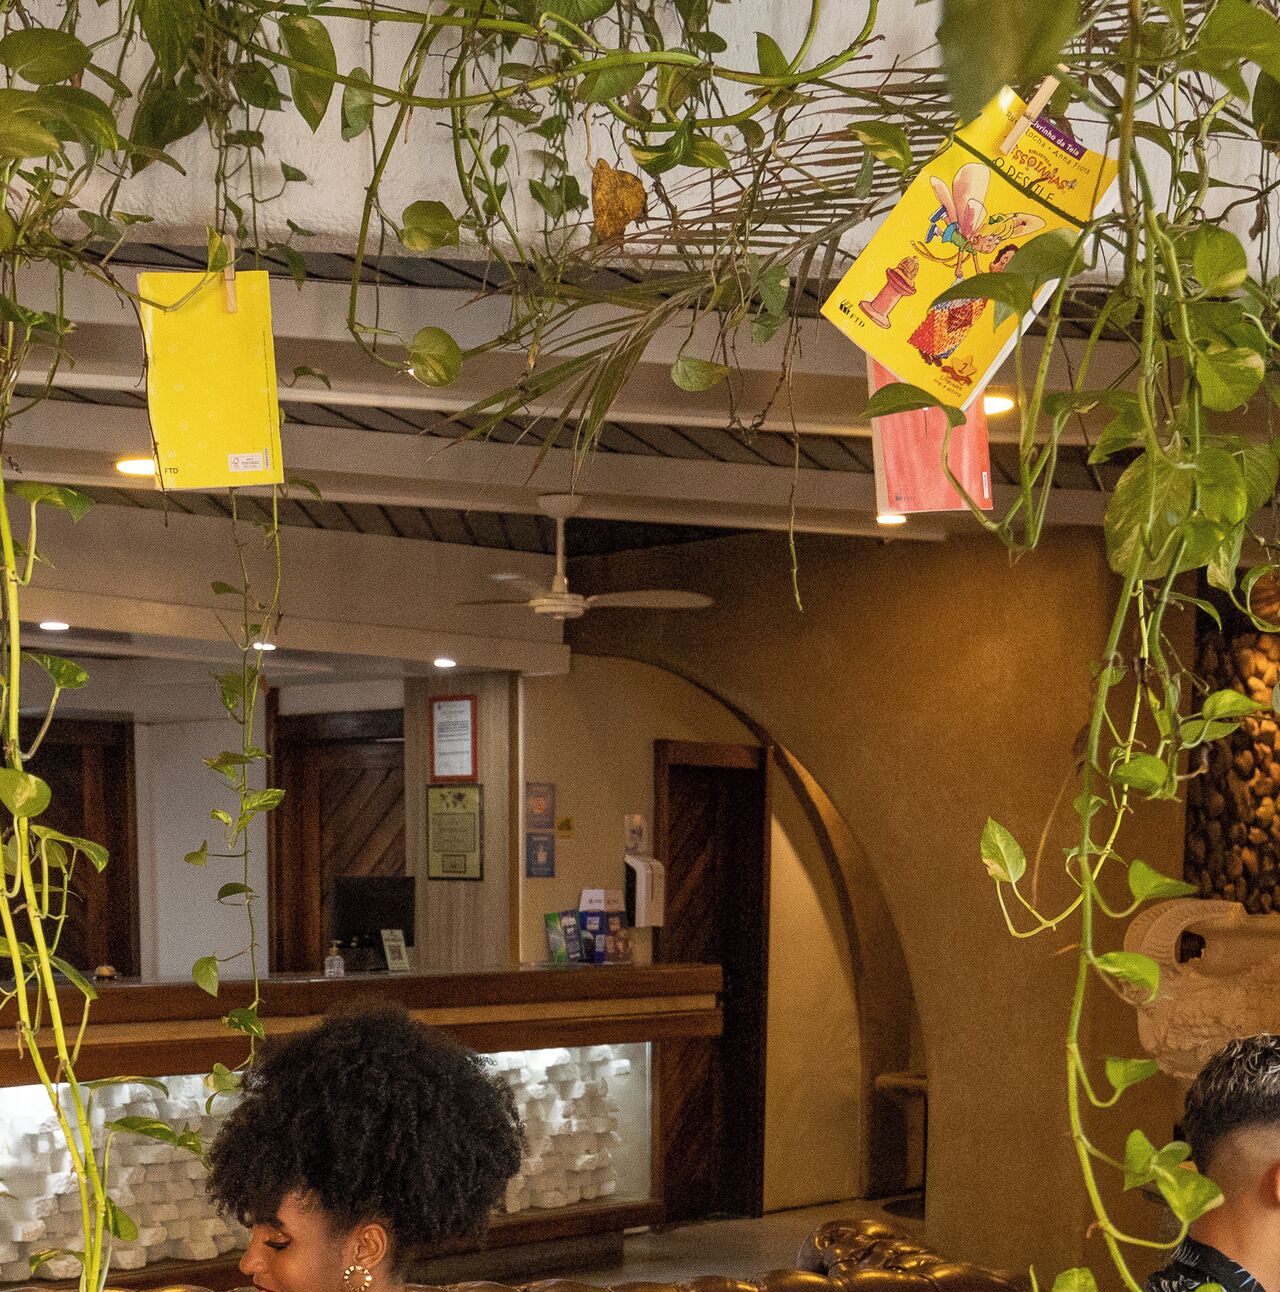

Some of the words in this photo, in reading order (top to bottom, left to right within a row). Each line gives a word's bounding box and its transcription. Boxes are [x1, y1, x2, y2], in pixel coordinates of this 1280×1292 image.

[1057, 139, 1066, 148] da
[1052, 150, 1072, 165] Anna
[1073, 162, 1091, 175] Flora
[849, 313, 865, 328] FTD
